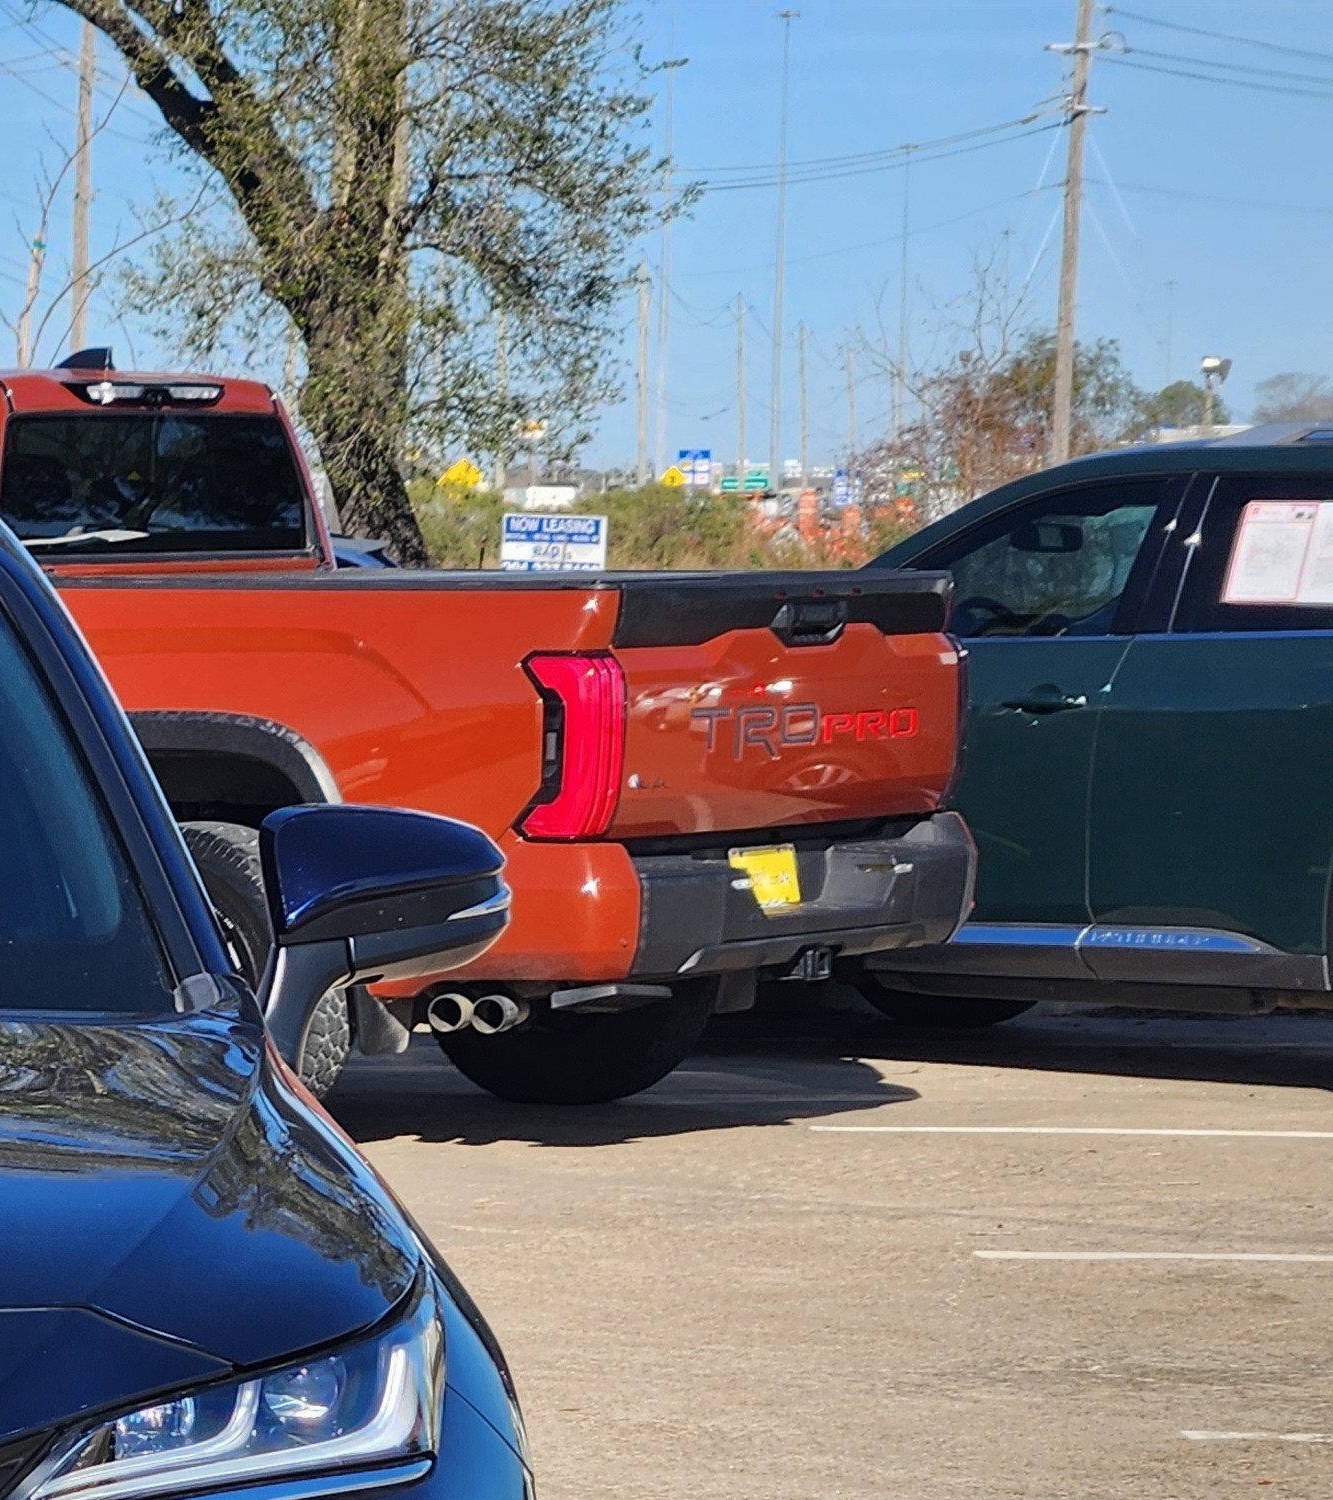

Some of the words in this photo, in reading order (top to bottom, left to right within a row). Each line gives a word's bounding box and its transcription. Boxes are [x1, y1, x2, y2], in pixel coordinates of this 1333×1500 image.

[509, 517, 540, 532] NOW
[542, 519, 597, 534] LEASING
[691, 703, 820, 761] TRD
[822, 707, 919, 744] PRO
